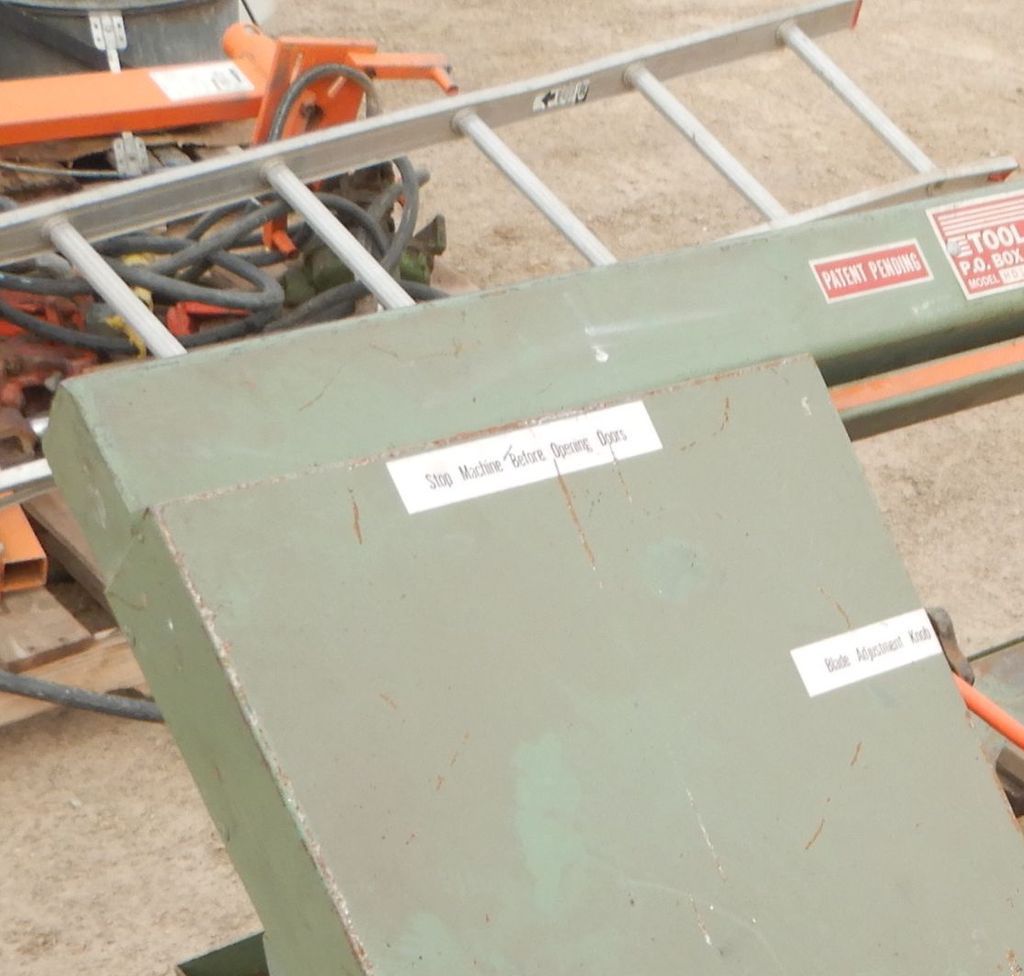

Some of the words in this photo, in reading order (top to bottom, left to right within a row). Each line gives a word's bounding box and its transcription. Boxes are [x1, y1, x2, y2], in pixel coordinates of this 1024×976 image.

[821, 263, 867, 290] PATENT
[868, 252, 921, 279] PENDING
[959, 257, 991, 275] P.O.
[991, 247, 1024, 268] BOX
[967, 274, 999, 289] MODEL
[425, 471, 454, 490] Stop
[458, 457, 504, 481] Machine
[509, 448, 546, 469] Before
[550, 437, 593, 460] Opening
[596, 427, 628, 447] Doors
[824, 653, 852, 673] Blade
[855, 635, 904, 662] Adjustment
[908, 626, 932, 645] Knob
